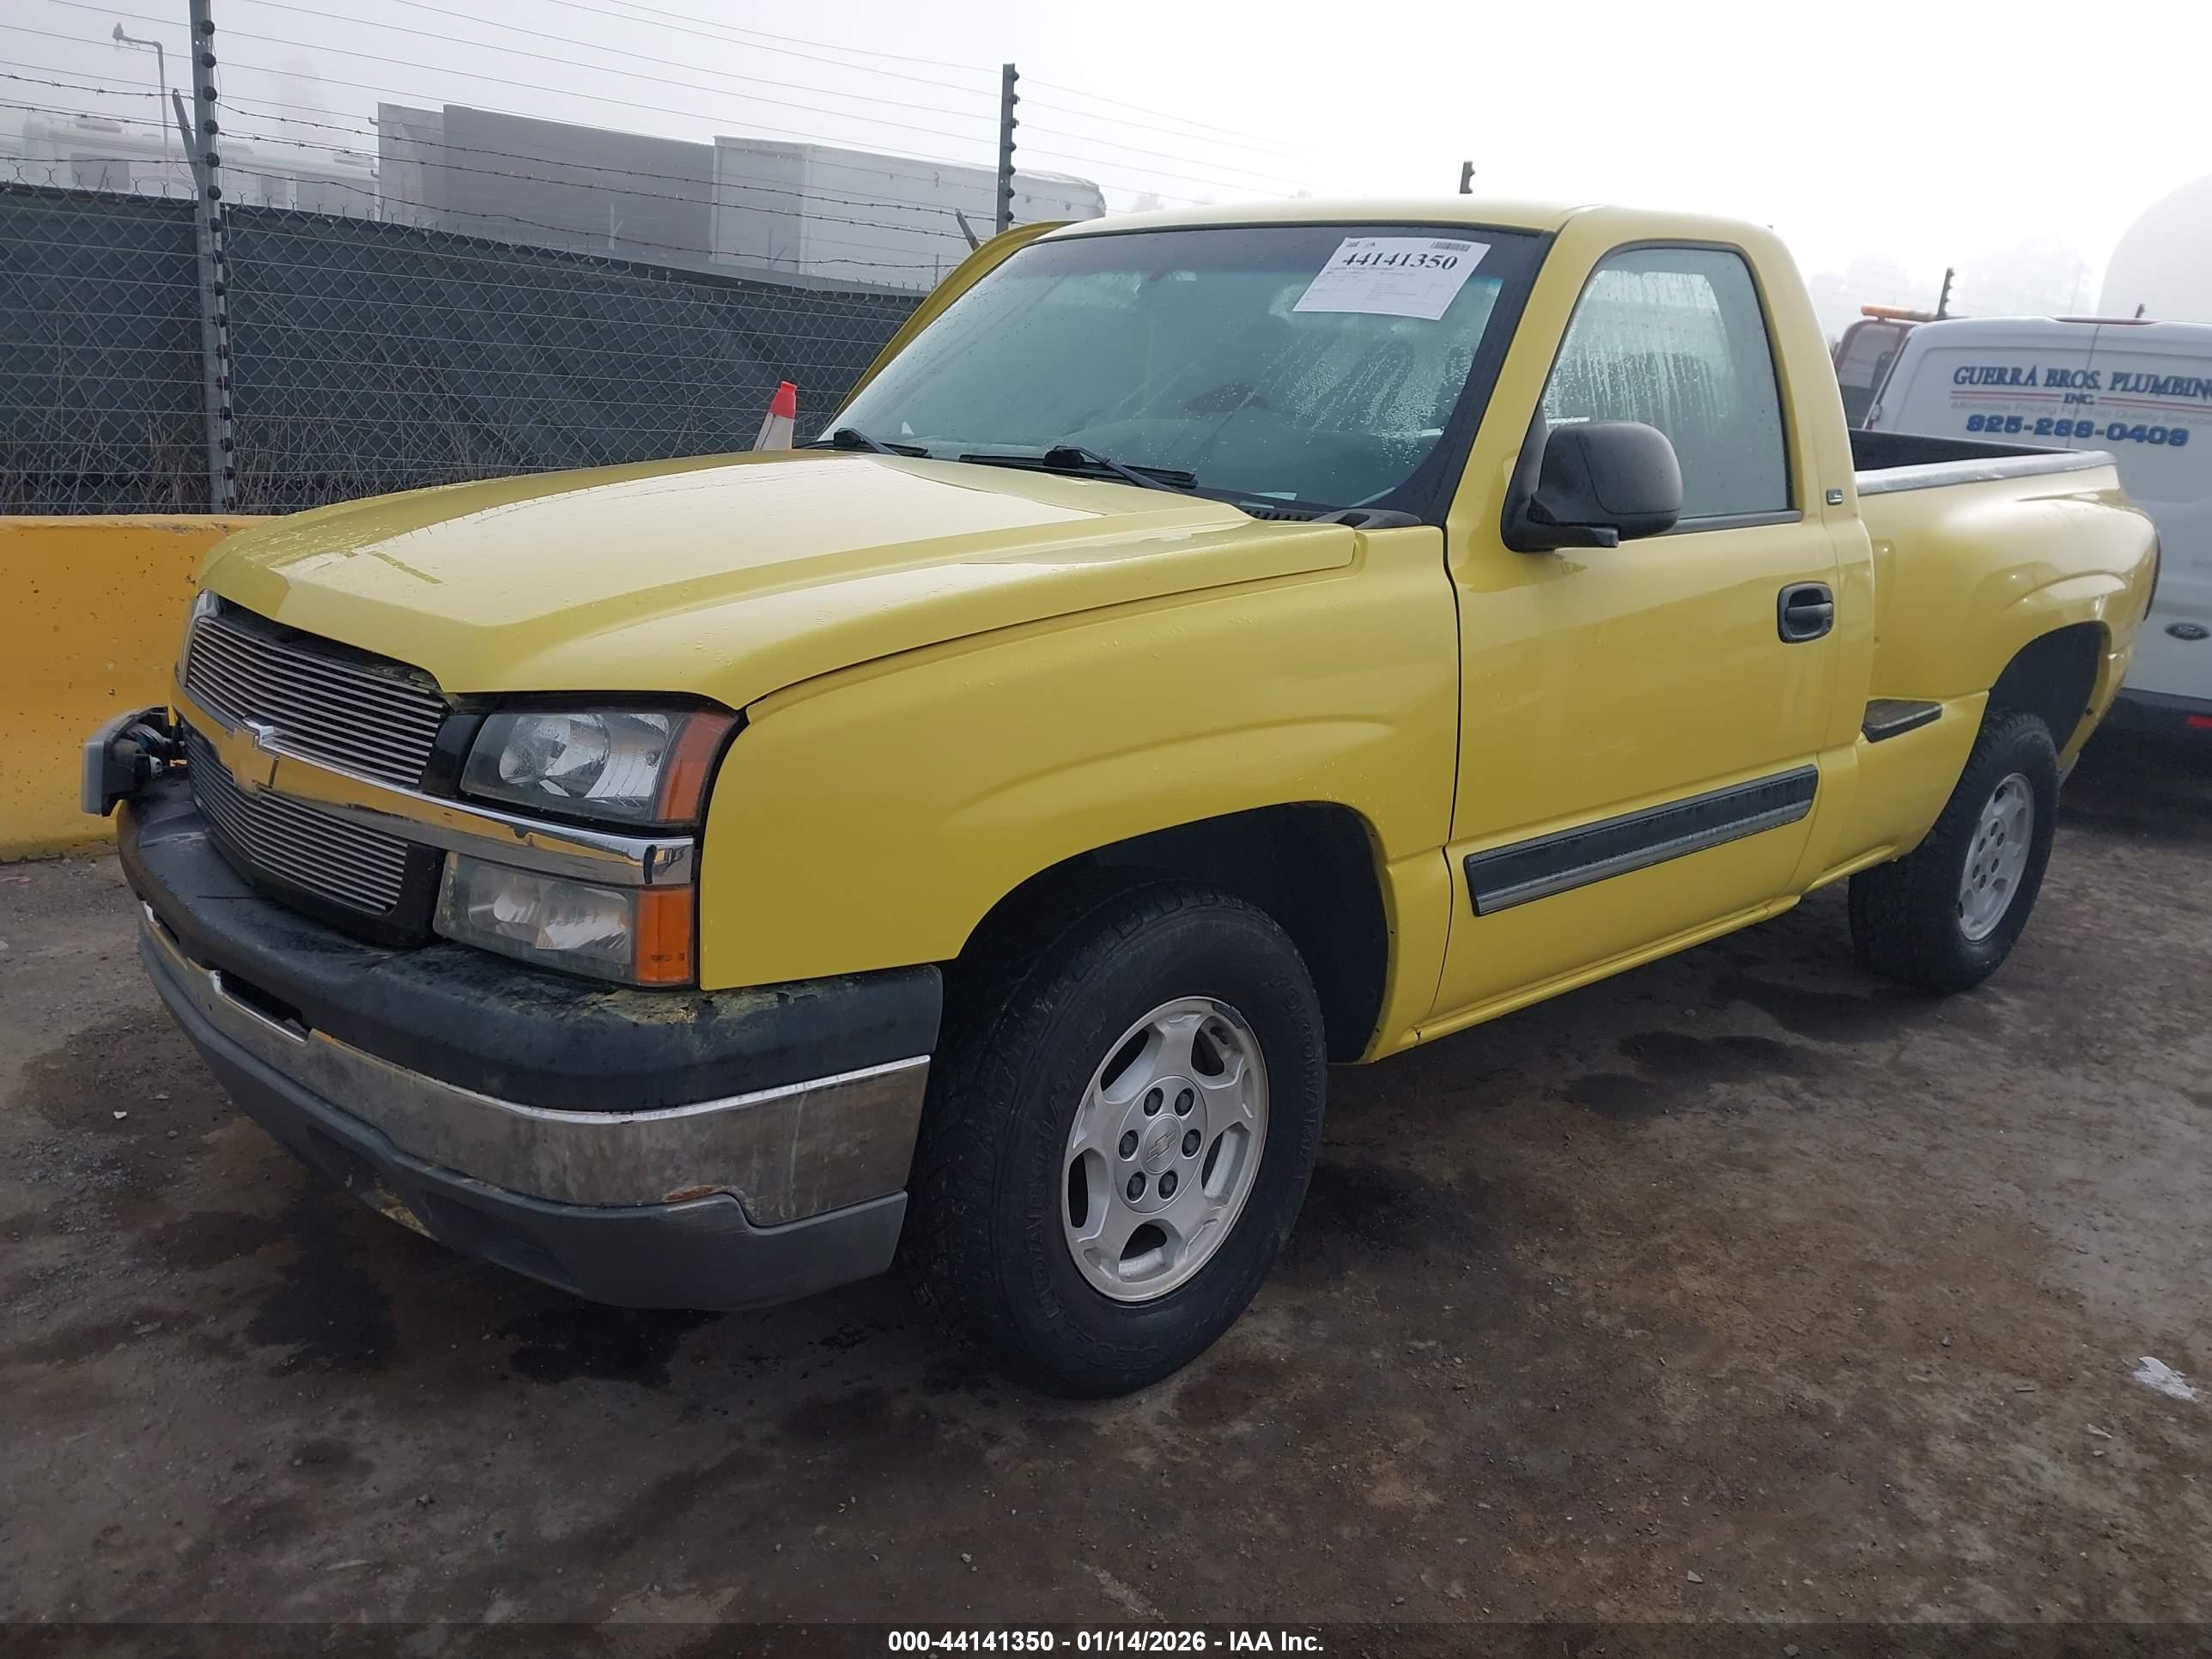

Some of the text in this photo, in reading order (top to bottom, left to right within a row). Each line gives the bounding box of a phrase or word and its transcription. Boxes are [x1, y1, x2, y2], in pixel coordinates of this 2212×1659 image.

[1342, 252, 1458, 270] 44141350
[1953, 365, 2212, 401] GUERRA BROS. PLUMBIN
[2063, 392, 2095, 405] INC.
